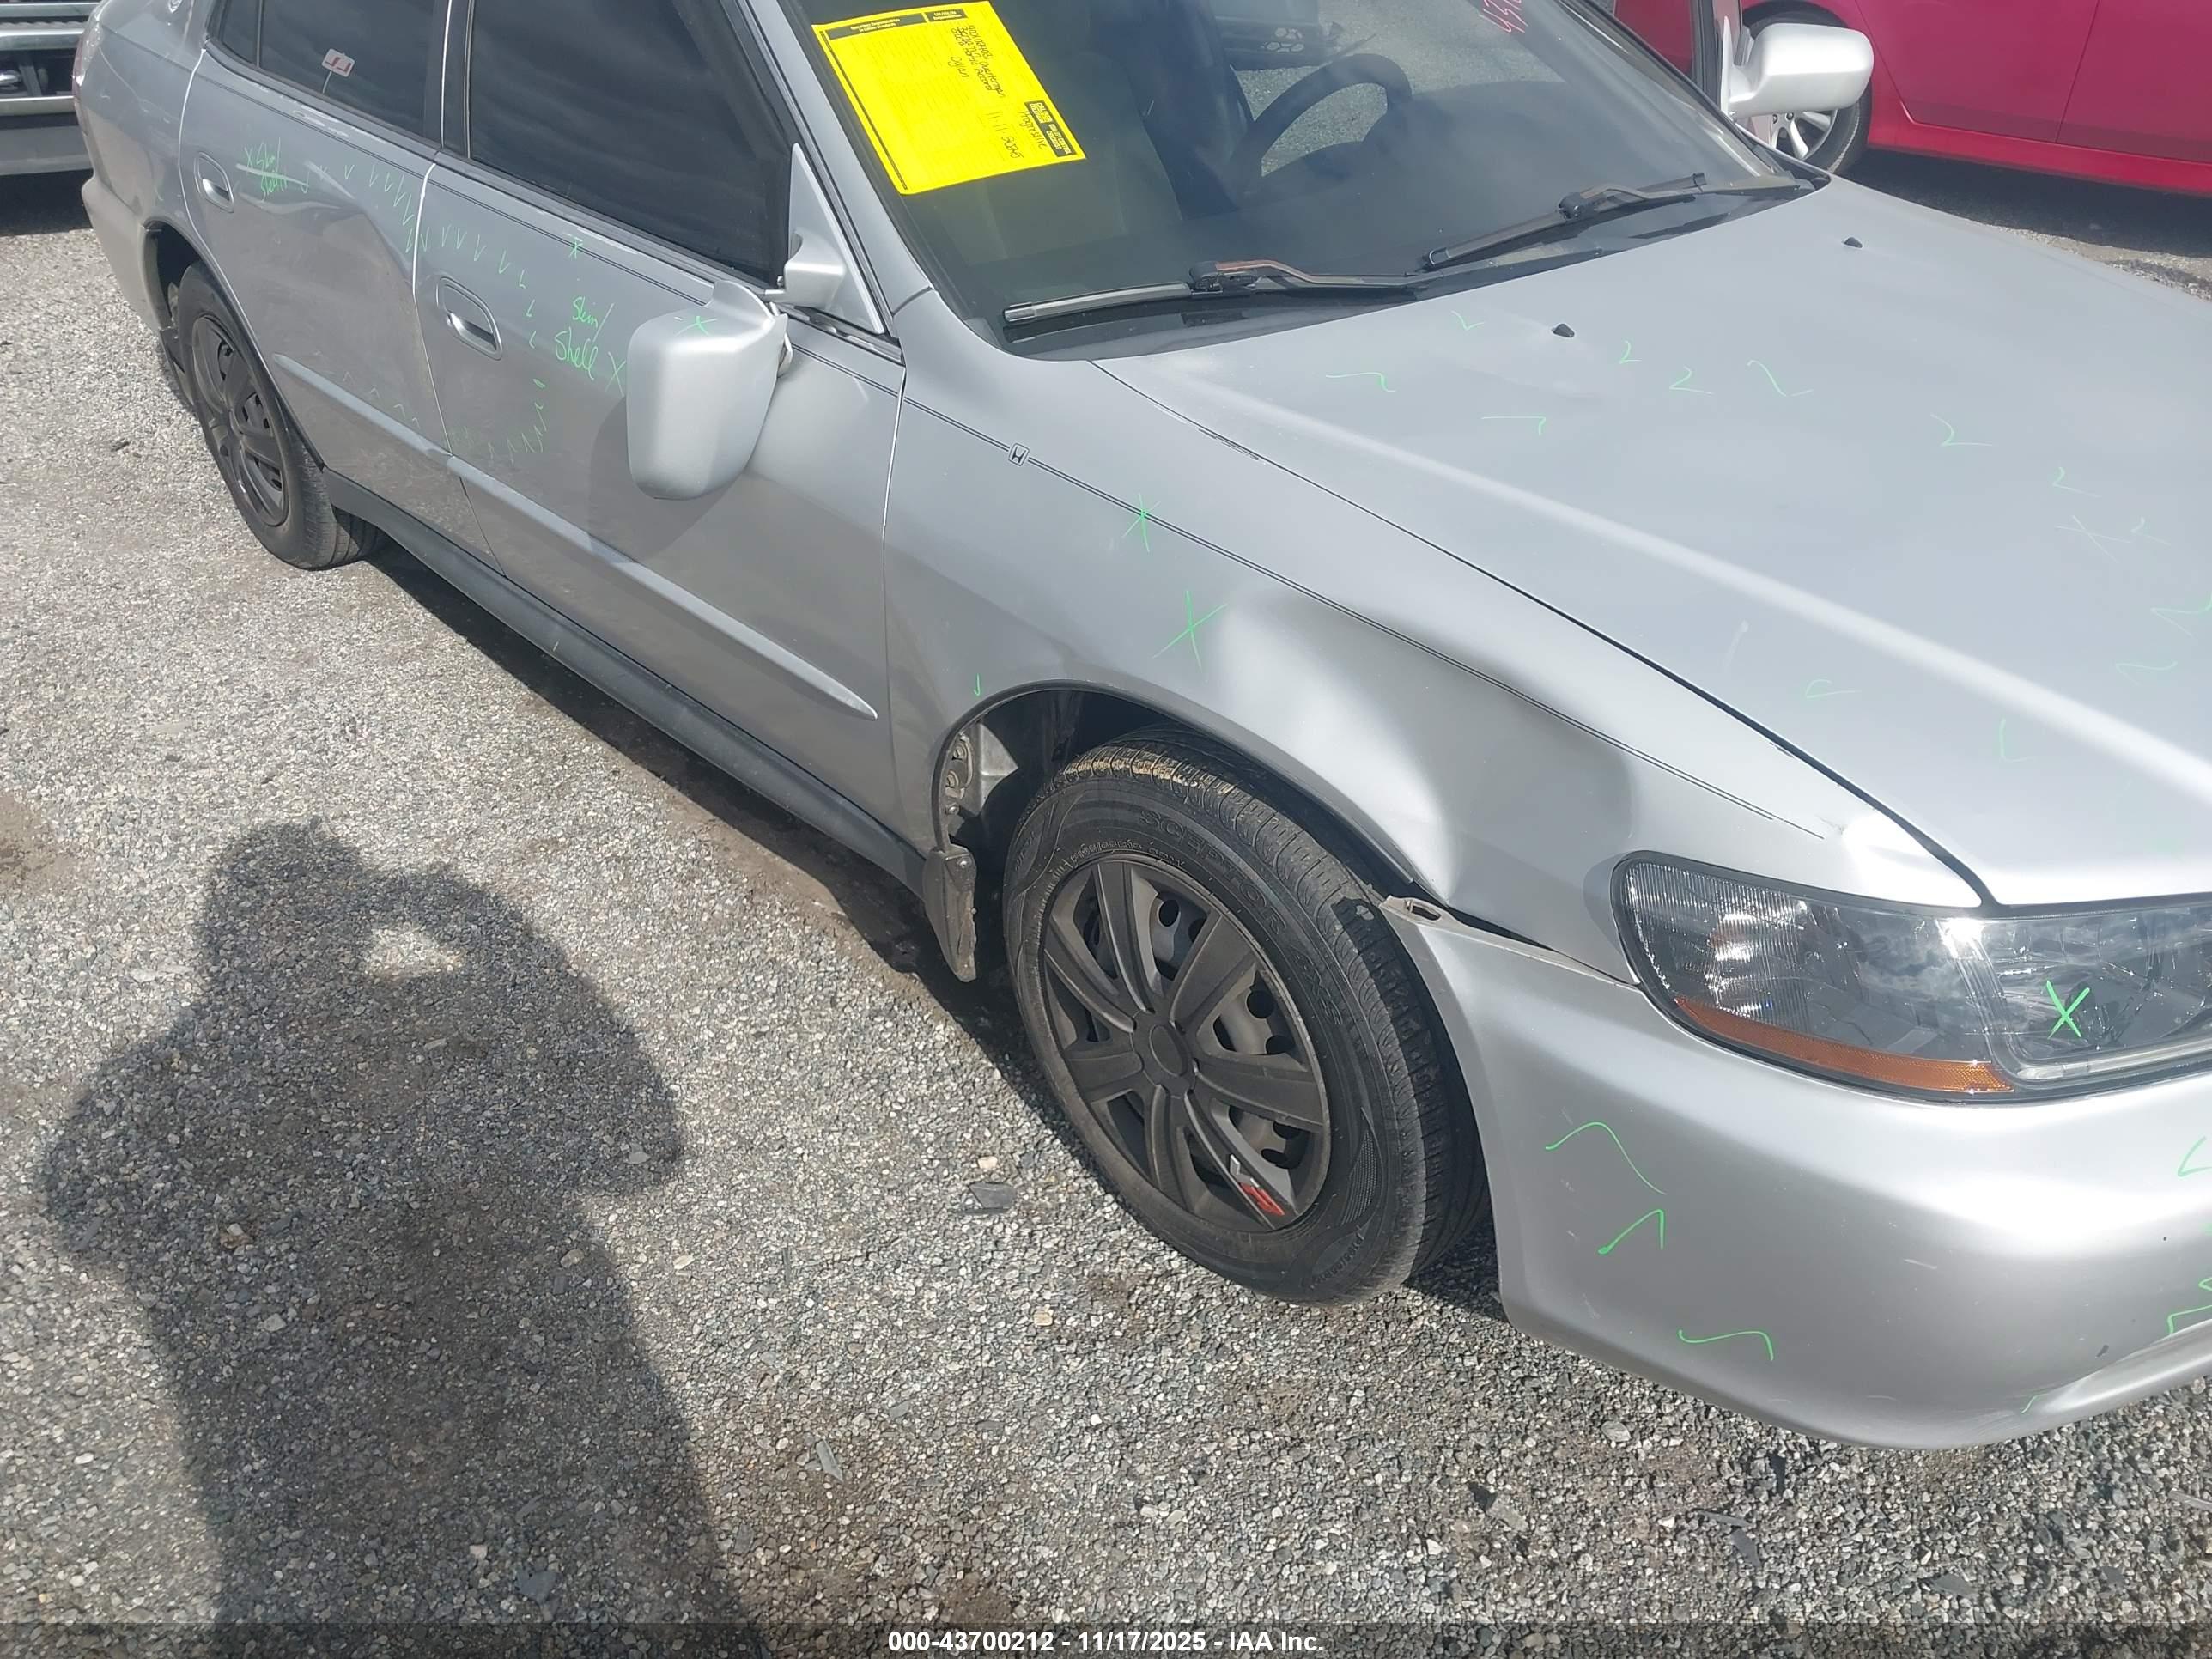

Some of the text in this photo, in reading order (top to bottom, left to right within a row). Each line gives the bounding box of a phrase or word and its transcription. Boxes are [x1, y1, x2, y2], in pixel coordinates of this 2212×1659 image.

[1017, 110, 1048, 150] Progressive
[554, 325, 599, 380] Shell
[1139, 809, 1287, 935] SCEPTOR
